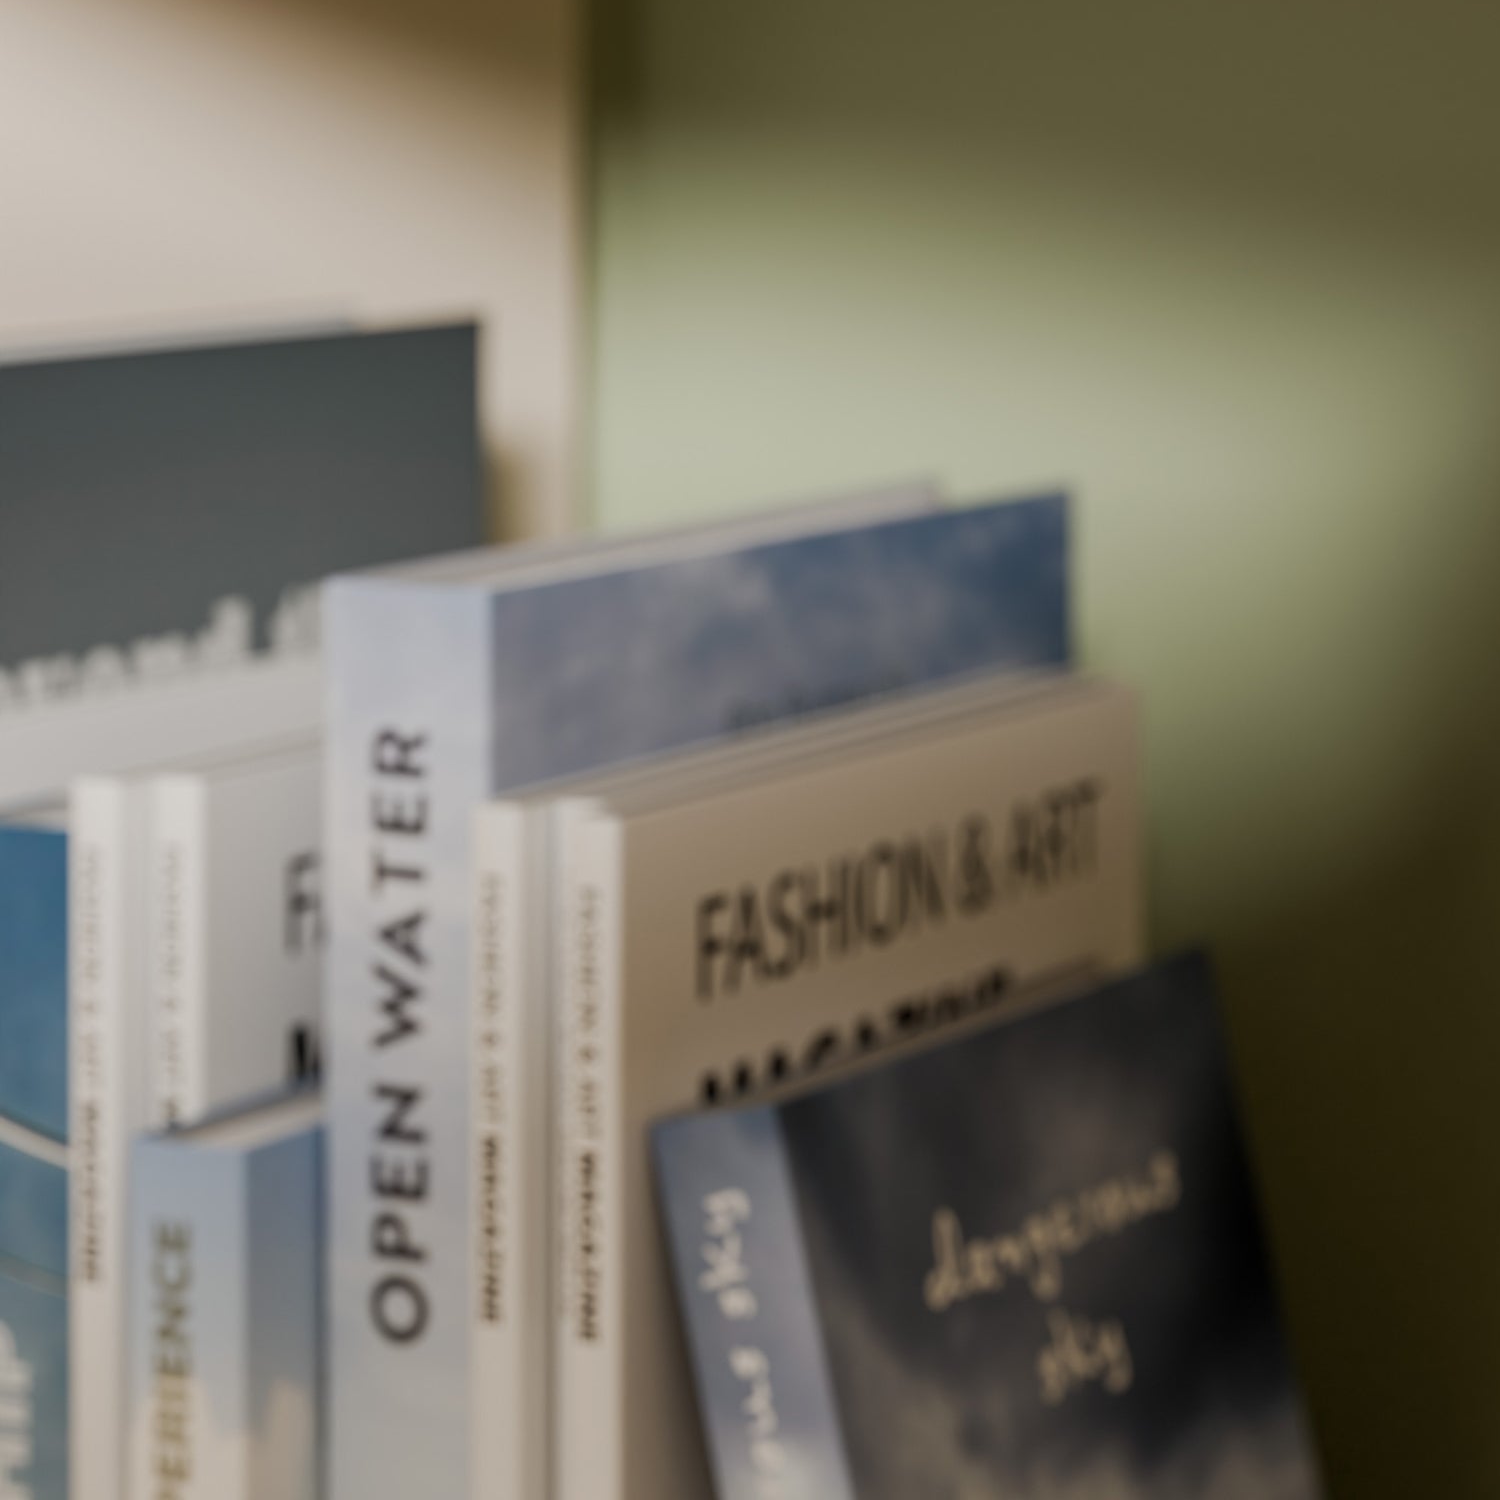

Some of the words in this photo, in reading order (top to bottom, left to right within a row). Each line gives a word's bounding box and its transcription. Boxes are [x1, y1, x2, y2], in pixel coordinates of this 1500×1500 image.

[371, 726, 429, 1049] WATER
[695, 827, 948, 1003] FASHION
[957, 812, 995, 918] &
[1008, 777, 1104, 888] ART
[370, 1082, 430, 1345] OPEN
